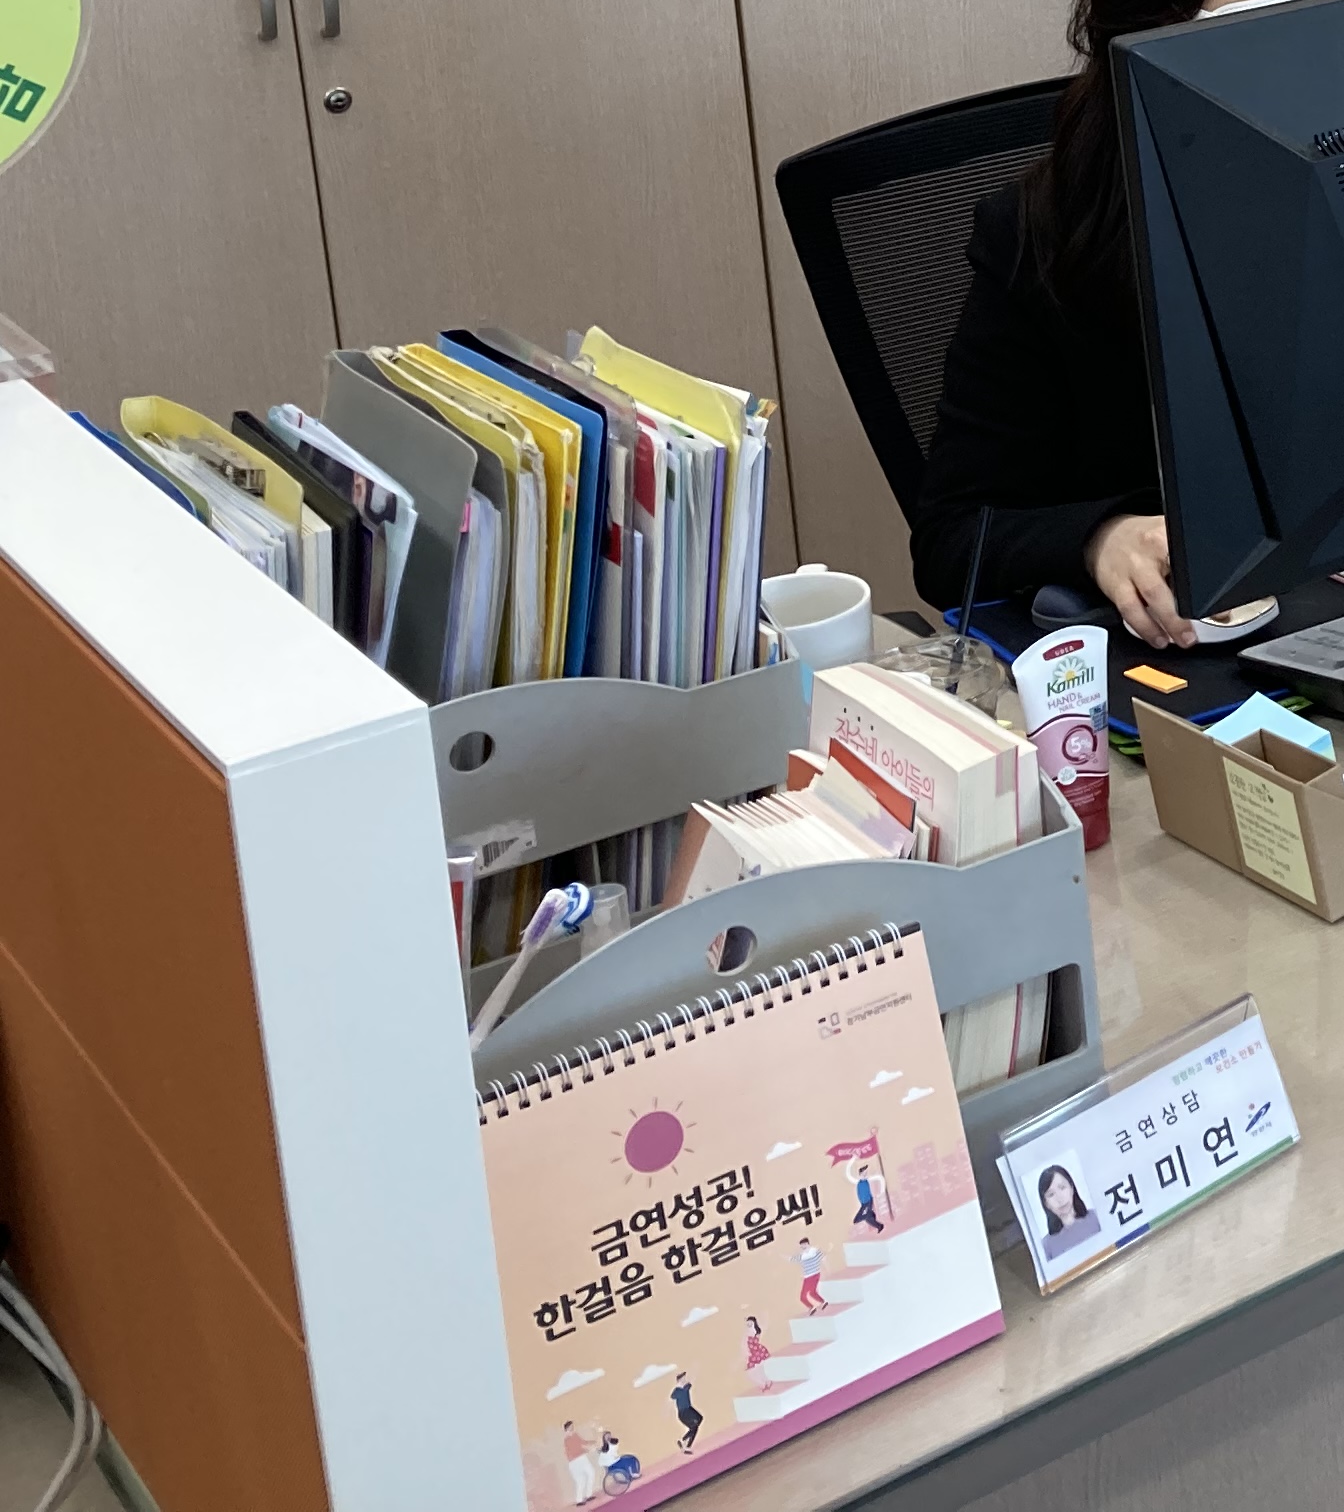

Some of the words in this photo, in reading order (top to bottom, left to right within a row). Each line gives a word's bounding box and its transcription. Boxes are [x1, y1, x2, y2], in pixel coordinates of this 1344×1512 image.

[1047, 666, 1095, 697] Kamill
[1047, 692, 1077, 710] HAND
[1076, 692, 1100, 708] CREAM
[1069, 736, 1091, 752] 5%
[881, 748, 935, 812] 아이들의
[1115, 1089, 1200, 1154] 금연상담
[1104, 1116, 1239, 1226] 전미연
[591, 1165, 755, 1267] 금연성공!
[533, 1262, 654, 1343] 한걸음
[661, 1184, 823, 1284] 한걸음씩!
